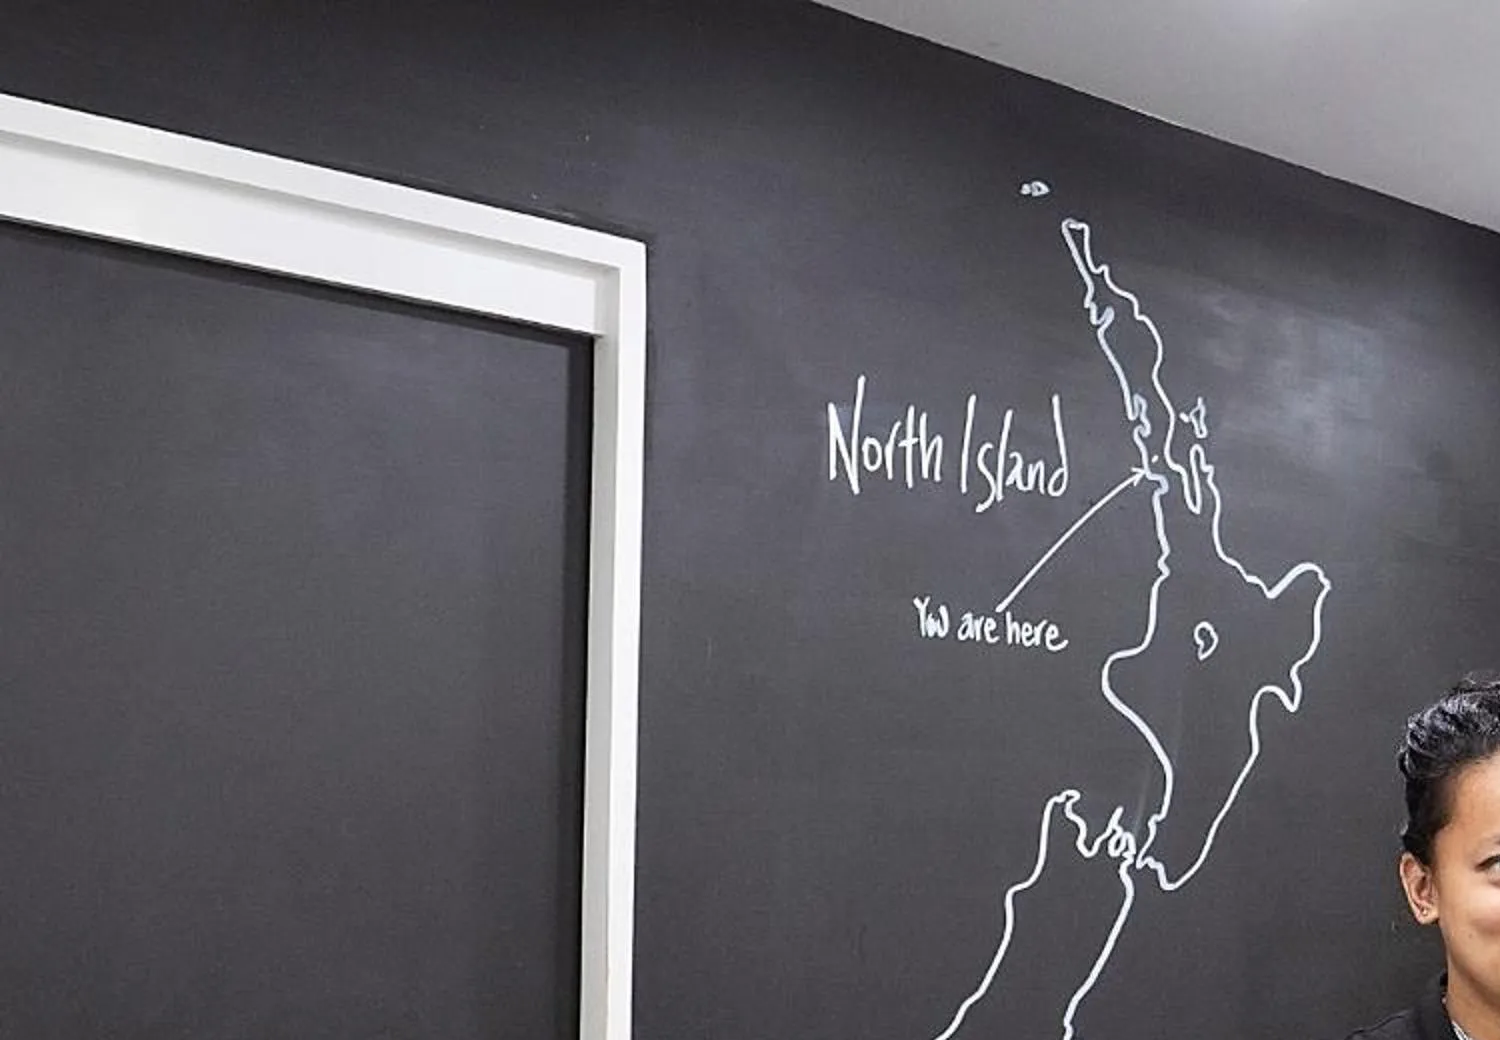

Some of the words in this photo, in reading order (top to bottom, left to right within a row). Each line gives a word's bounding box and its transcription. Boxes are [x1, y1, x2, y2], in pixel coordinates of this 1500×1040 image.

[827, 374, 943, 496] North
[960, 393, 1069, 513] Island
[957, 611, 1000, 643] are
[1005, 610, 1069, 652] here
